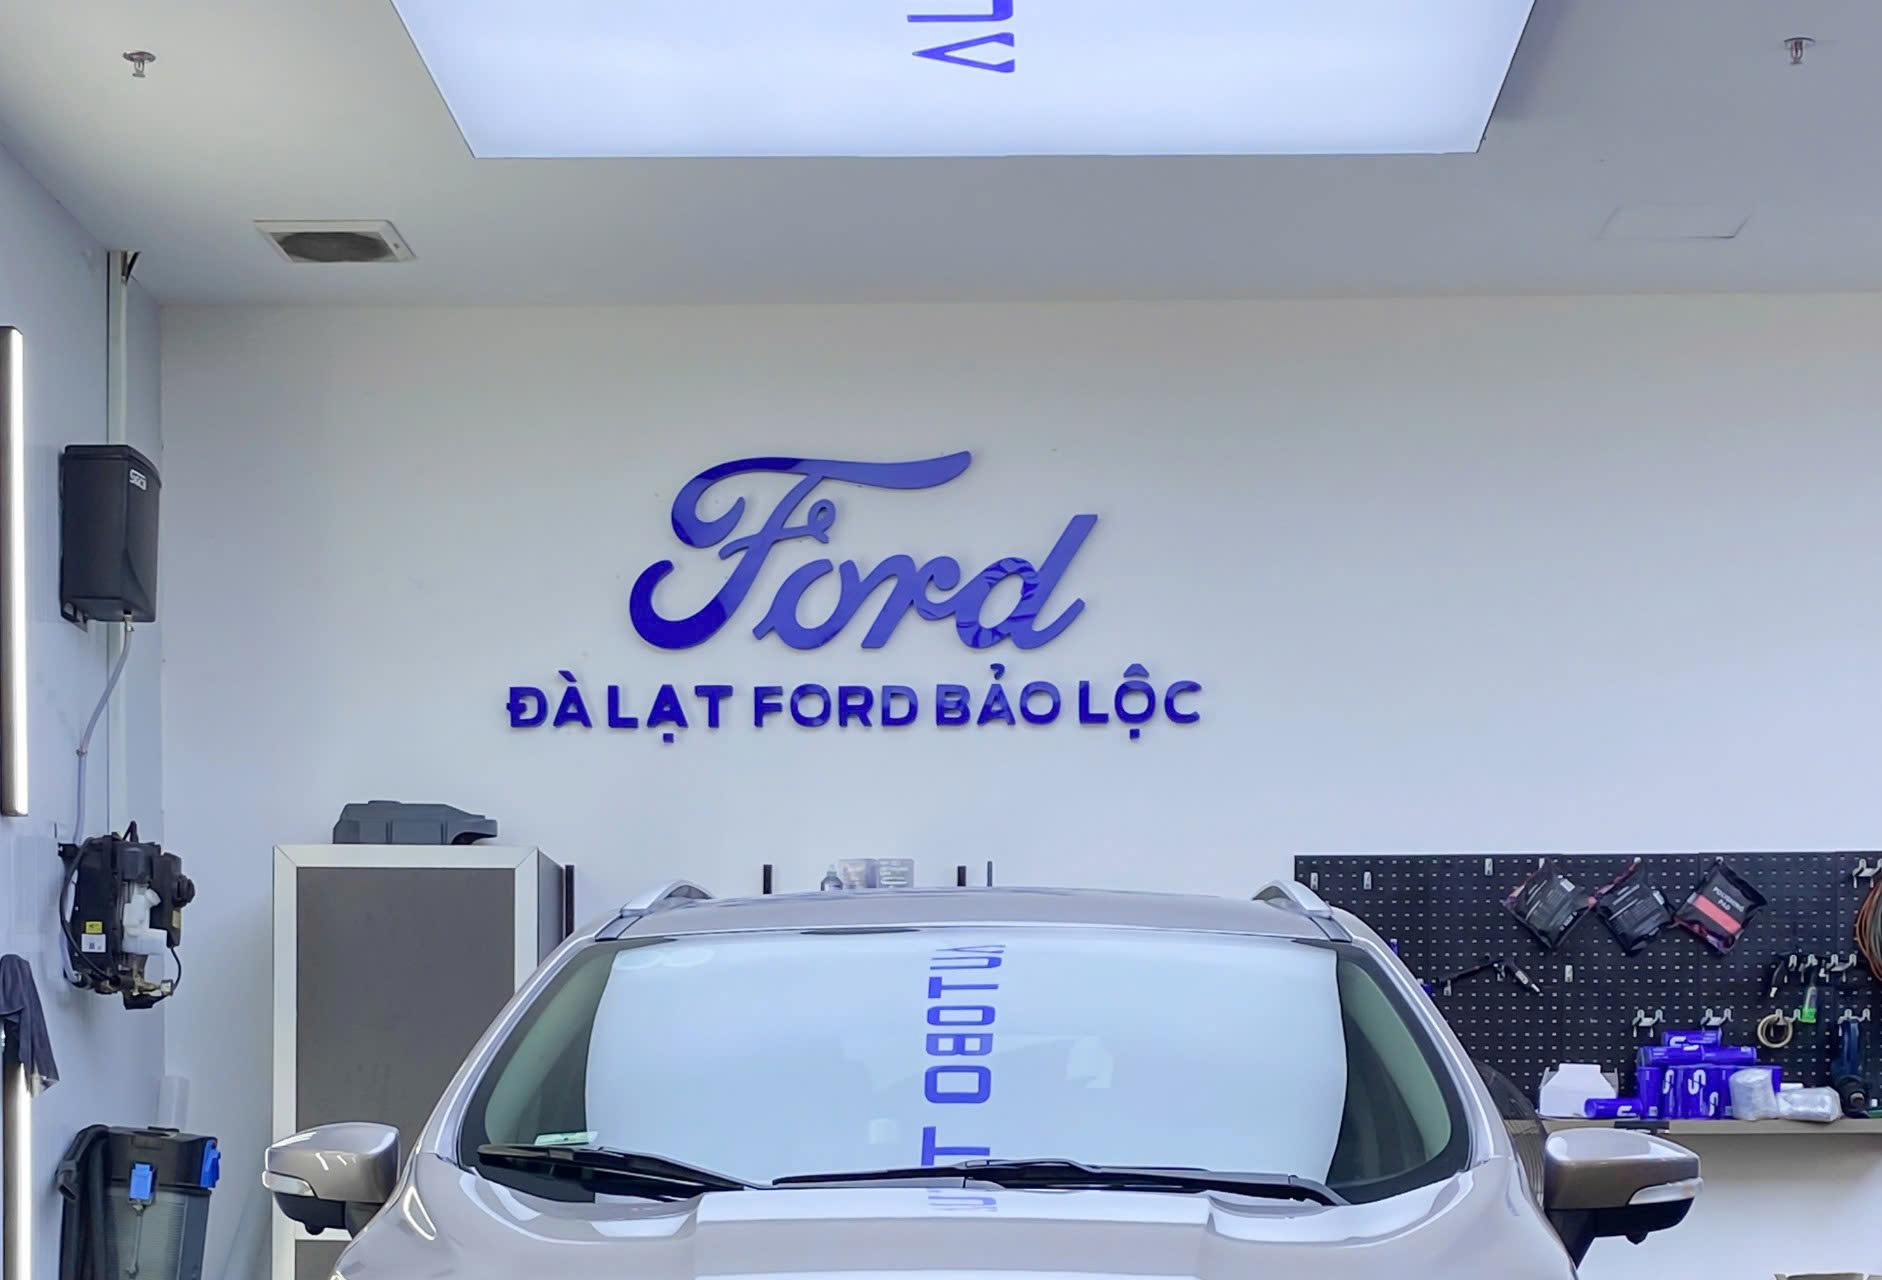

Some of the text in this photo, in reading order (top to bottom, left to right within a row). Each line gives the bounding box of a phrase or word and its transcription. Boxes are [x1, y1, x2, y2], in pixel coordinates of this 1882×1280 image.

[629, 450, 1098, 650] Ford
[506, 662, 1202, 743] ĐÀ LẠT FORD BẢO LỘC
